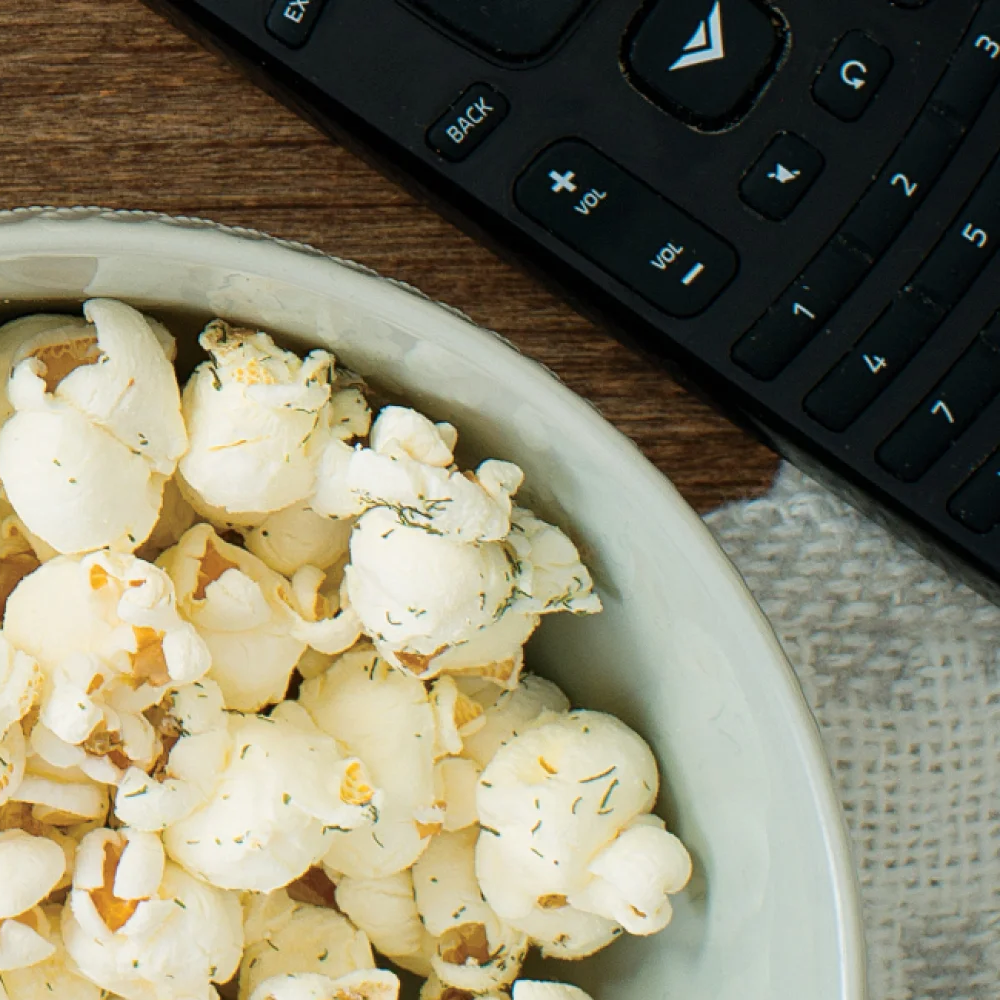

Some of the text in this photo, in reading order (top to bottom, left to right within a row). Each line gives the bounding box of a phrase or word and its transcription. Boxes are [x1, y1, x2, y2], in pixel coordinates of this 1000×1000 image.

[974, 34, 1000, 59] 3
[445, 96, 494, 144] BACK
[890, 172, 918, 197] 2
[573, 188, 608, 215] VOL
[961, 222, 988, 248] 5
[649, 242, 684, 270] VOL
[792, 301, 815, 321] 1
[862, 352, 887, 374] 4
[930, 400, 955, 424] 7
